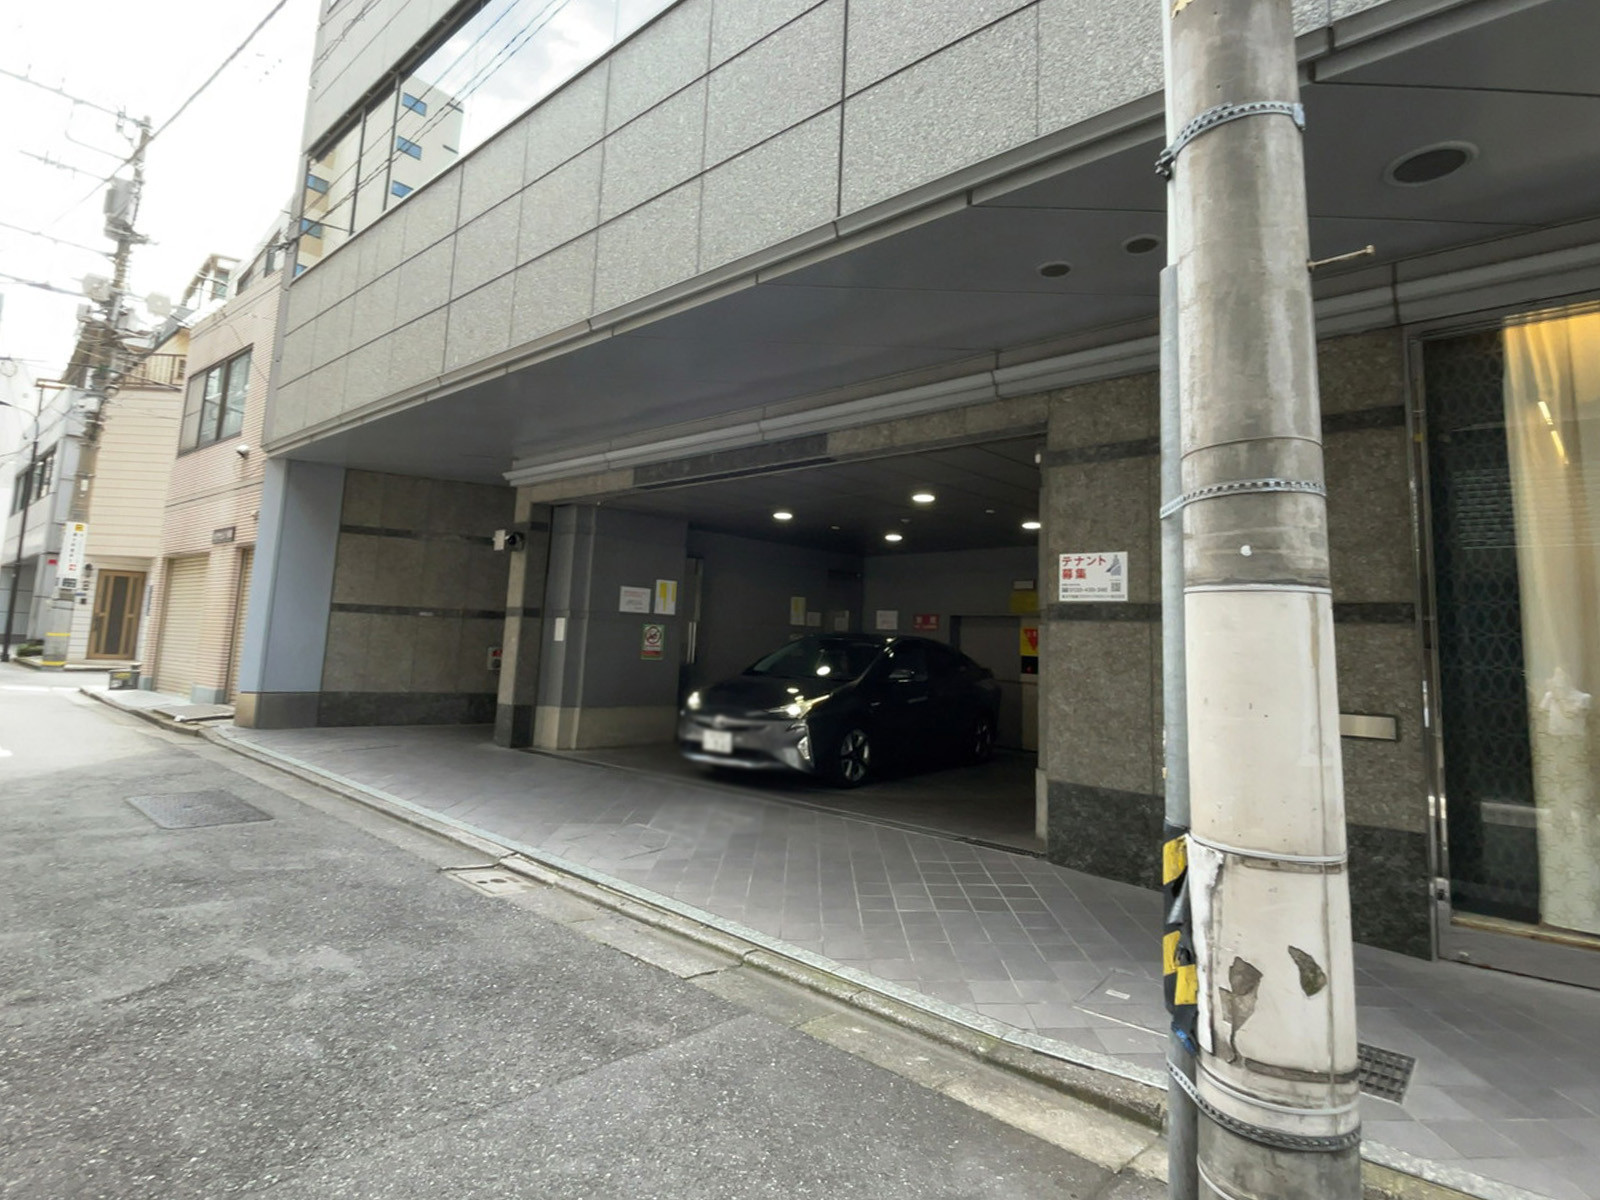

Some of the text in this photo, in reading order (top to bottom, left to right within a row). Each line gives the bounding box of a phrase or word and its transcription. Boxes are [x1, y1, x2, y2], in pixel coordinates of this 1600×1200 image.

[1062, 555, 1106, 567] テナント
[1062, 568, 1087, 580] 募集
